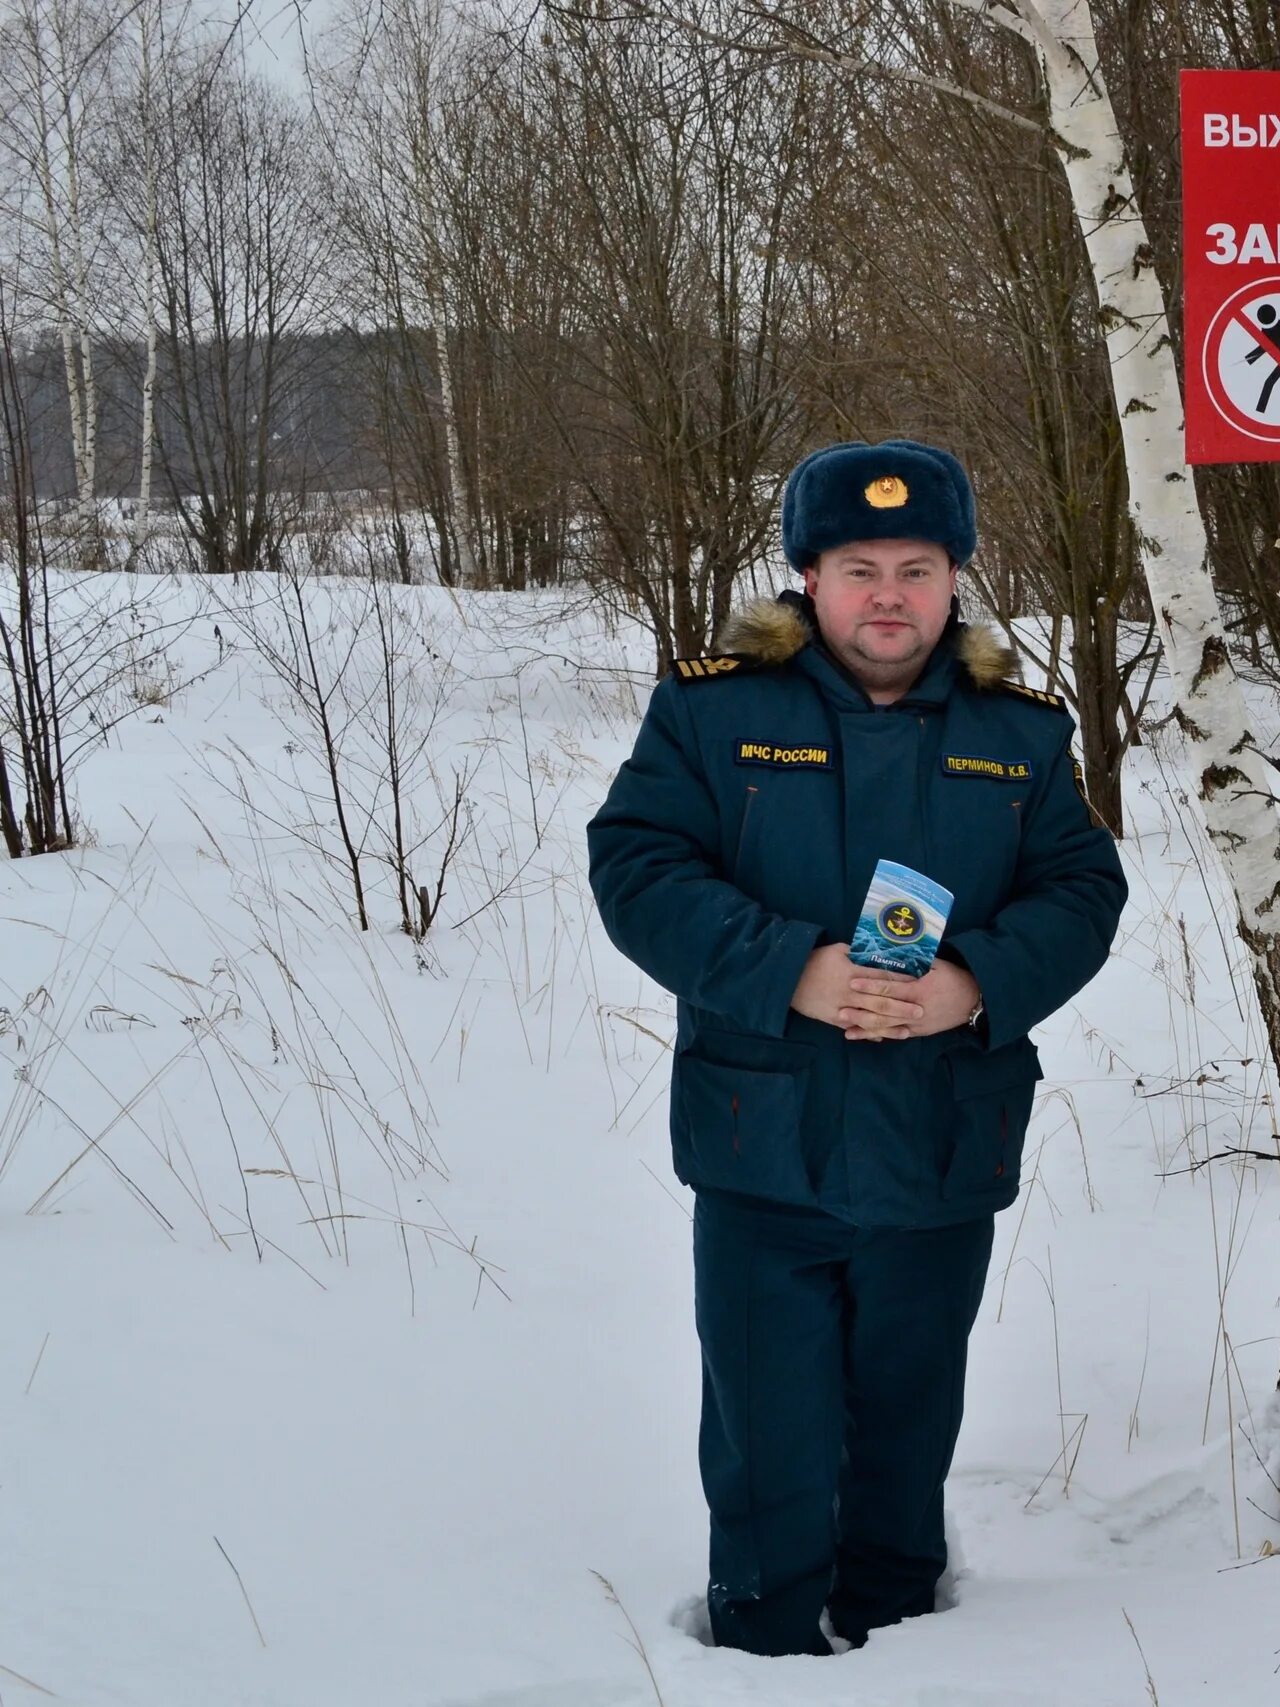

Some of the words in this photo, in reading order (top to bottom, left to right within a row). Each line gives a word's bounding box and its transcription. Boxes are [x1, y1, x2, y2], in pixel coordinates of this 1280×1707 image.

[741, 744, 771, 760] МЧС
[773, 748, 827, 763] РОССИИ
[948, 757, 1004, 775] ПЕРМИНОВ
[1008, 765, 1029, 777] К.В.
[870, 954, 906, 969] Памятка
